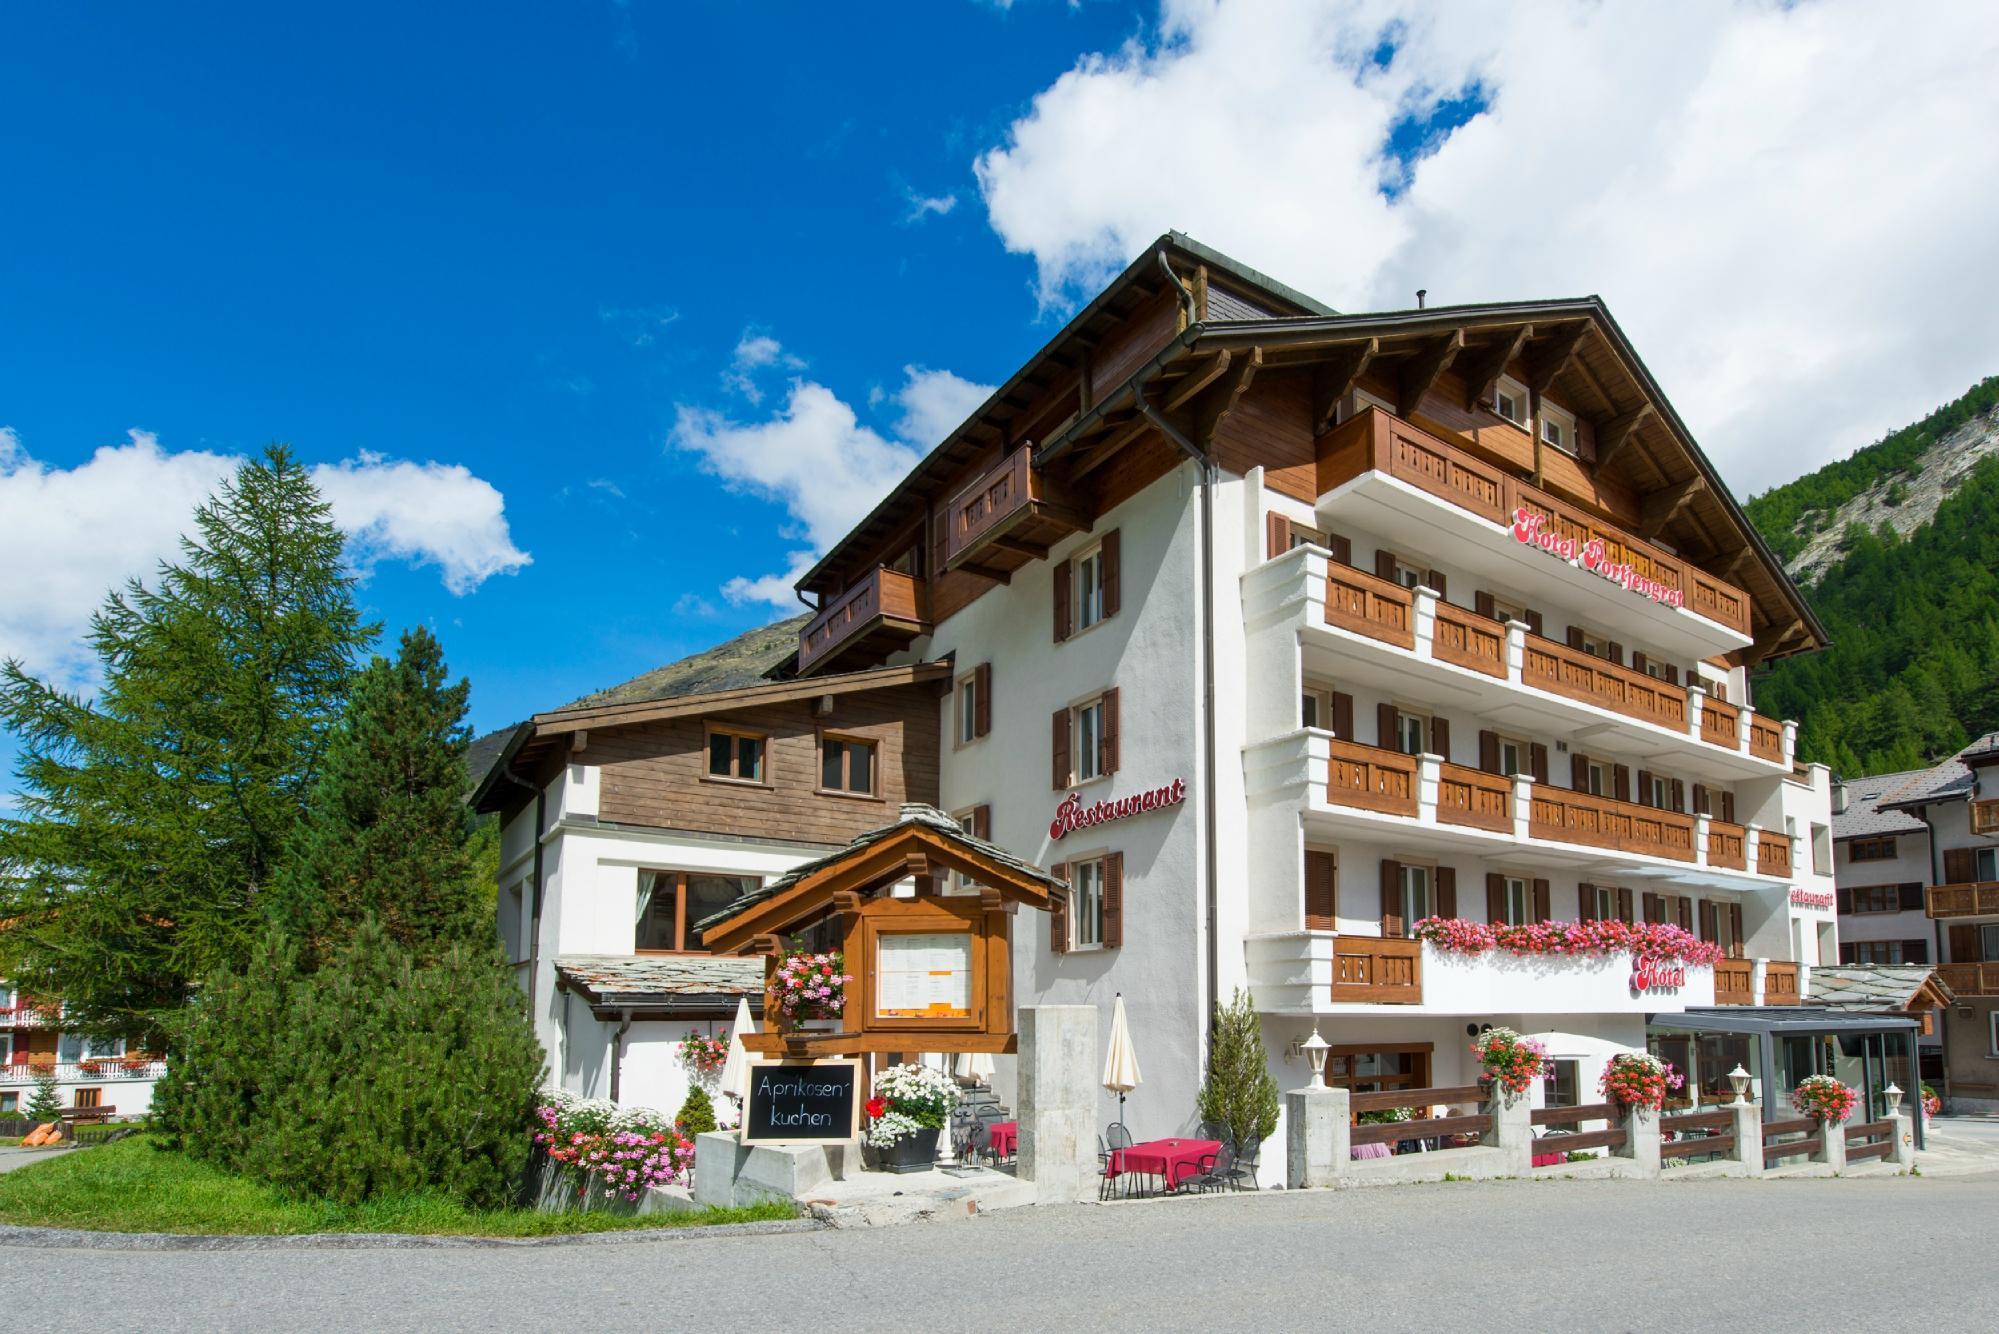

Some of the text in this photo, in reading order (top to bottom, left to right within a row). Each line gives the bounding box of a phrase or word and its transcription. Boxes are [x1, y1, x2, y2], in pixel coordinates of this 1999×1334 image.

[1510, 507, 1685, 608] Hotel Portjengrat
[1049, 777, 1186, 840] Restaurant
[1789, 888, 1834, 907] estaurant
[1633, 953, 1686, 991] Hotel
[769, 1102, 832, 1127] kuchen
